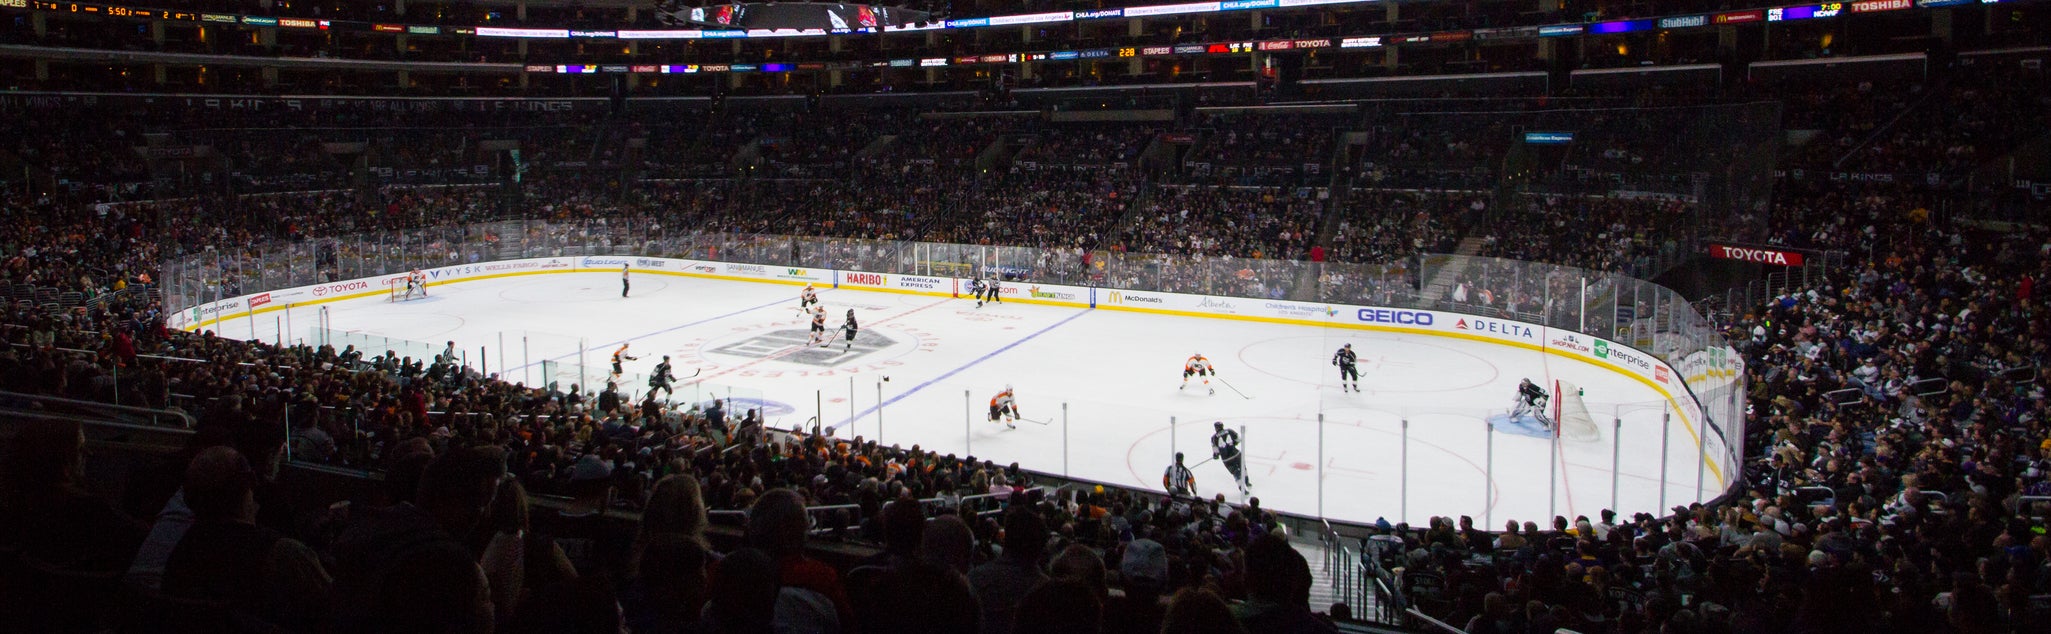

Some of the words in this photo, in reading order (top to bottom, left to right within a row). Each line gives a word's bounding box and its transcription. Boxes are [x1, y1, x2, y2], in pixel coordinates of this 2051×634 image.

[71, 4, 77, 12] 0
[108, 7, 126, 16] 5:50
[1821, 3, 1841, 11] 7:00
[1852, 0, 1910, 11] TOSHIBA
[163, 11, 168, 19] 2
[280, 19, 316, 27] TOSHIBA
[1662, 15, 1704, 28] StubHub!
[1295, 39, 1331, 49] TOYOTA
[1722, 246, 1787, 266] TOYOTA
[445, 265, 481, 277] VYSK
[846, 272, 881, 285] HARIBO
[901, 276, 940, 284] AMERICAN
[329, 281, 368, 293] TOYOTA
[1125, 295, 1163, 304] McDonald's
[1196, 296, 1236, 308] Alberta
[1265, 302, 1296, 310] Children's
[1298, 304, 1328, 313] Hospital
[1358, 308, 1433, 326] GEICO
[1475, 319, 1532, 338] DELTA
[1552, 339, 1589, 353] SHOP.NHL.COM
[1595, 342, 1649, 370] enterprise
[1217, 434, 1235, 449] 44
